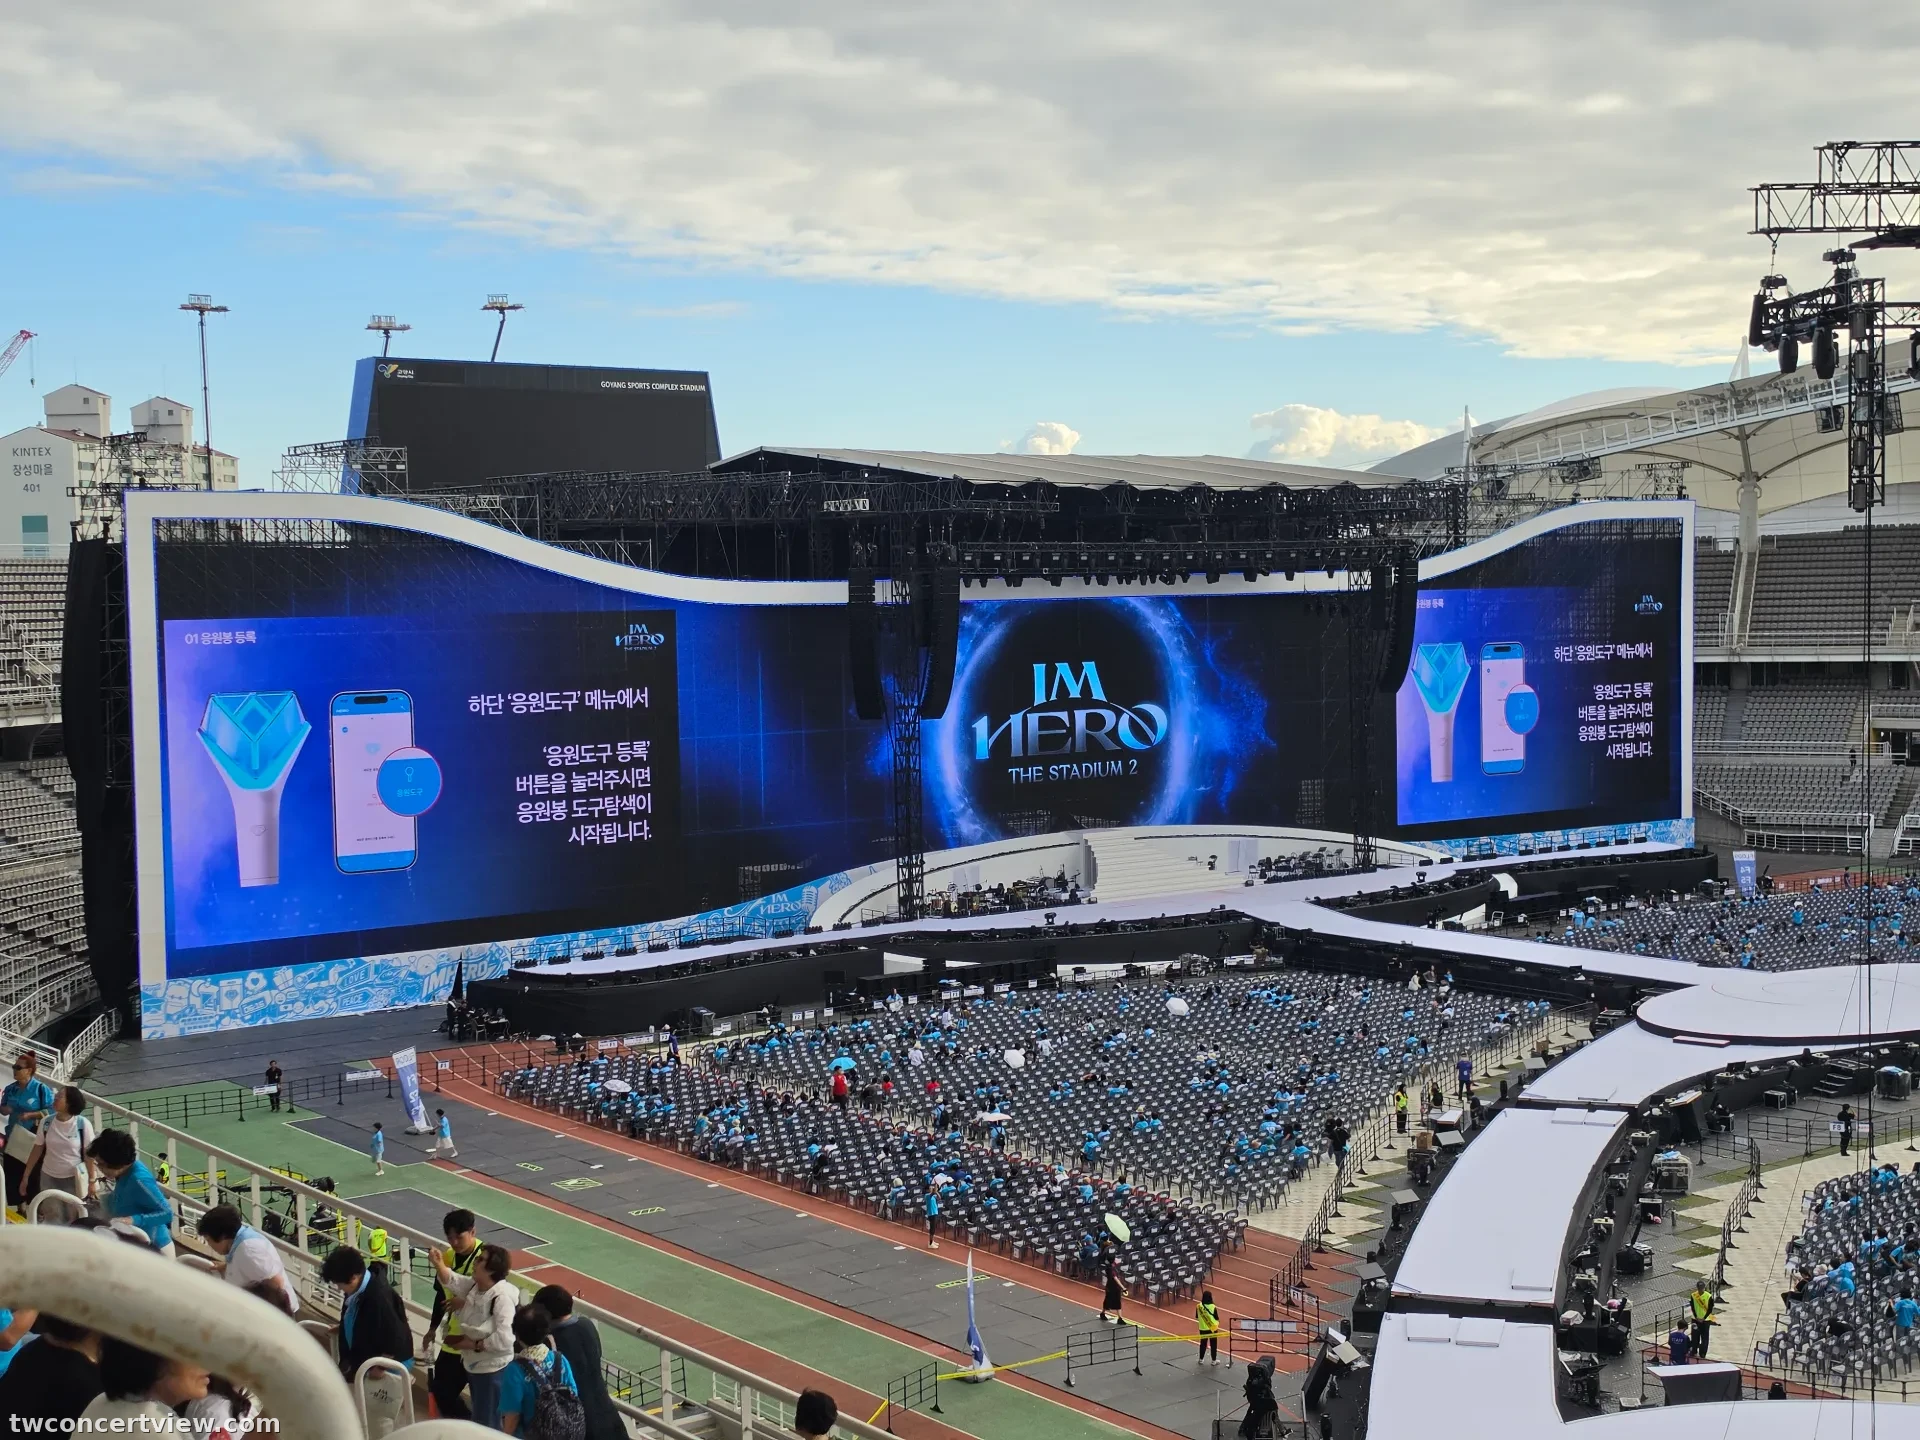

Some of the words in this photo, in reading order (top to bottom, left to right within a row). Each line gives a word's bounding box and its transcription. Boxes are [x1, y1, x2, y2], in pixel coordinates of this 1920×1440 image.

[600, 381, 626, 389] GOYANG
[628, 382, 650, 390] SPORTS
[651, 383, 679, 391] COMPLEX
[680, 384, 706, 392] STADIUM
[12, 447, 52, 457] KINTEX
[13, 463, 53, 476] 장성마을
[23, 483, 41, 492] 401
[184, 633, 199, 645] 01
[201, 631, 233, 645] 응원봉
[235, 630, 257, 644] 등록
[629, 623, 649, 635] IM
[615, 633, 665, 647] HERO
[1554, 645, 1574, 662] 하단
[1616, 642, 1653, 659] 메뉴에서
[1032, 661, 1108, 707] IM
[468, 693, 505, 716] 하단
[585, 687, 649, 711] 메뉴에서
[1578, 705, 1607, 722] 버튼을
[1608, 701, 1654, 720] 눌러주시면
[972, 703, 1168, 760] HERO
[1578, 724, 1607, 742] 응원봉
[1608, 721, 1653, 739] 도구탐색이
[1606, 741, 1654, 760] 시작됩니다.
[516, 772, 568, 796] 버튼을
[570, 766, 652, 793] 눌러주시면
[1008, 765, 1044, 784] THE
[1049, 760, 1124, 781] STADIUM
[1129, 759, 1138, 775] 2
[516, 799, 568, 824] 응원봉
[571, 792, 652, 819] 도구탐색이
[568, 819, 652, 846] 시작됩니다.
[760, 900, 802, 915] HERO
[771, 893, 788, 904] IM
[344, 968, 366, 987] LOVE
